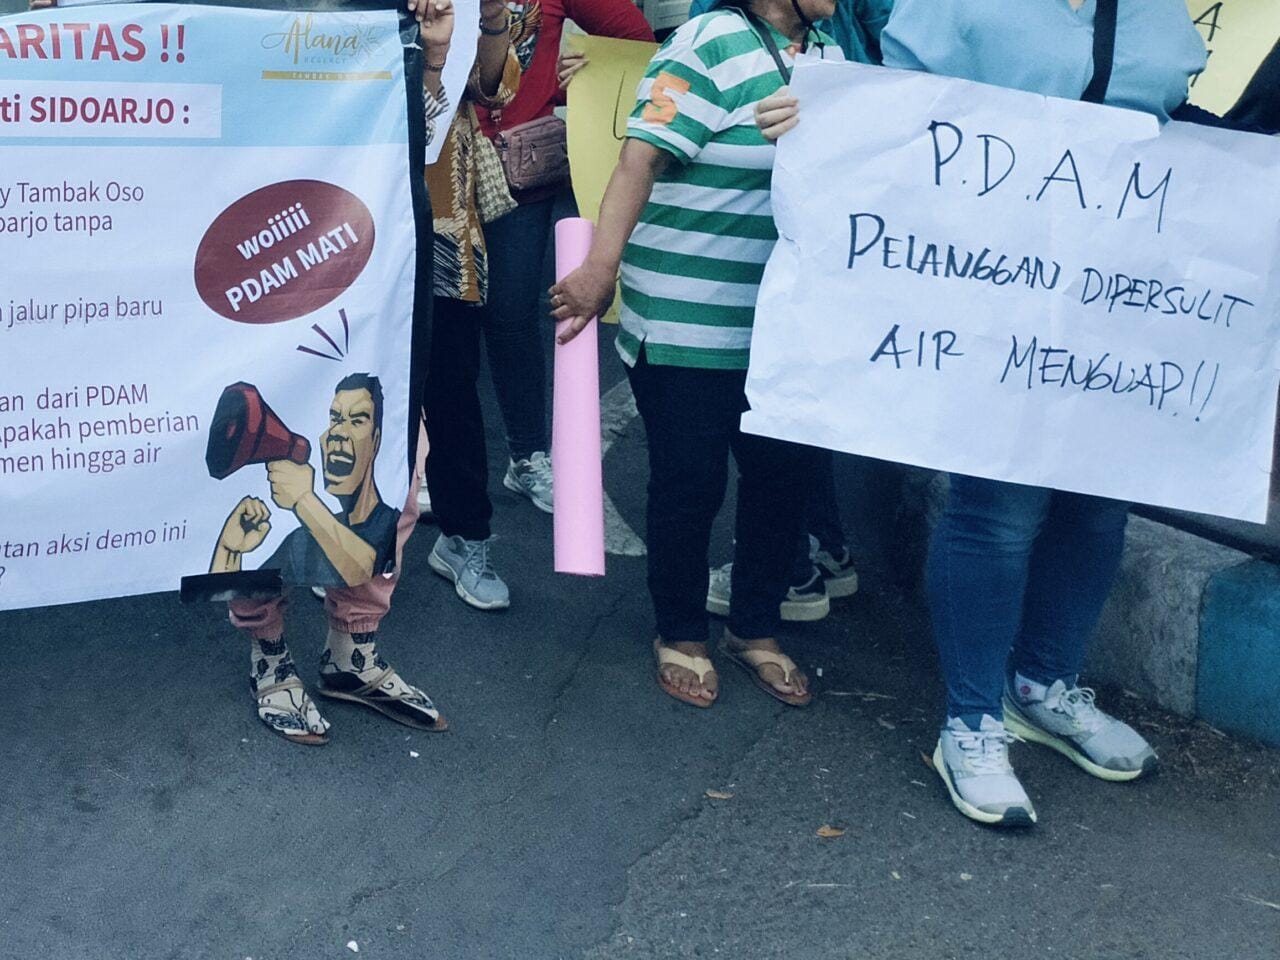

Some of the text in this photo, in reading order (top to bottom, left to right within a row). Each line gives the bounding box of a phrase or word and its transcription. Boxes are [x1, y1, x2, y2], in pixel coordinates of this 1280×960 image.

[260, 11, 359, 65] Alana
[30, 96, 174, 124] SIDOARJO
[641, 72, 691, 125] 5
[17, 181, 99, 203] Tambak
[106, 182, 144, 202] Oso
[54, 212, 112, 236] tanpa
[237, 202, 311, 260] woiiiii
[225, 222, 359, 312] PDAM MATI
[9, 299, 57, 328] jalur
[64, 300, 109, 324] pipa
[116, 296, 163, 317] baru
[1080, 267, 1255, 328] DIPERSULIT
[870, 324, 965, 370] AIR
[36, 387, 79, 410] dari
[86, 383, 148, 406] PDAM
[79, 412, 199, 438] pemberian
[51, 447, 126, 472] hingga
[133, 443, 162, 464] air
[46, 532, 89, 556] aksi
[96, 528, 156, 549] demo
[162, 520, 187, 542] ini
